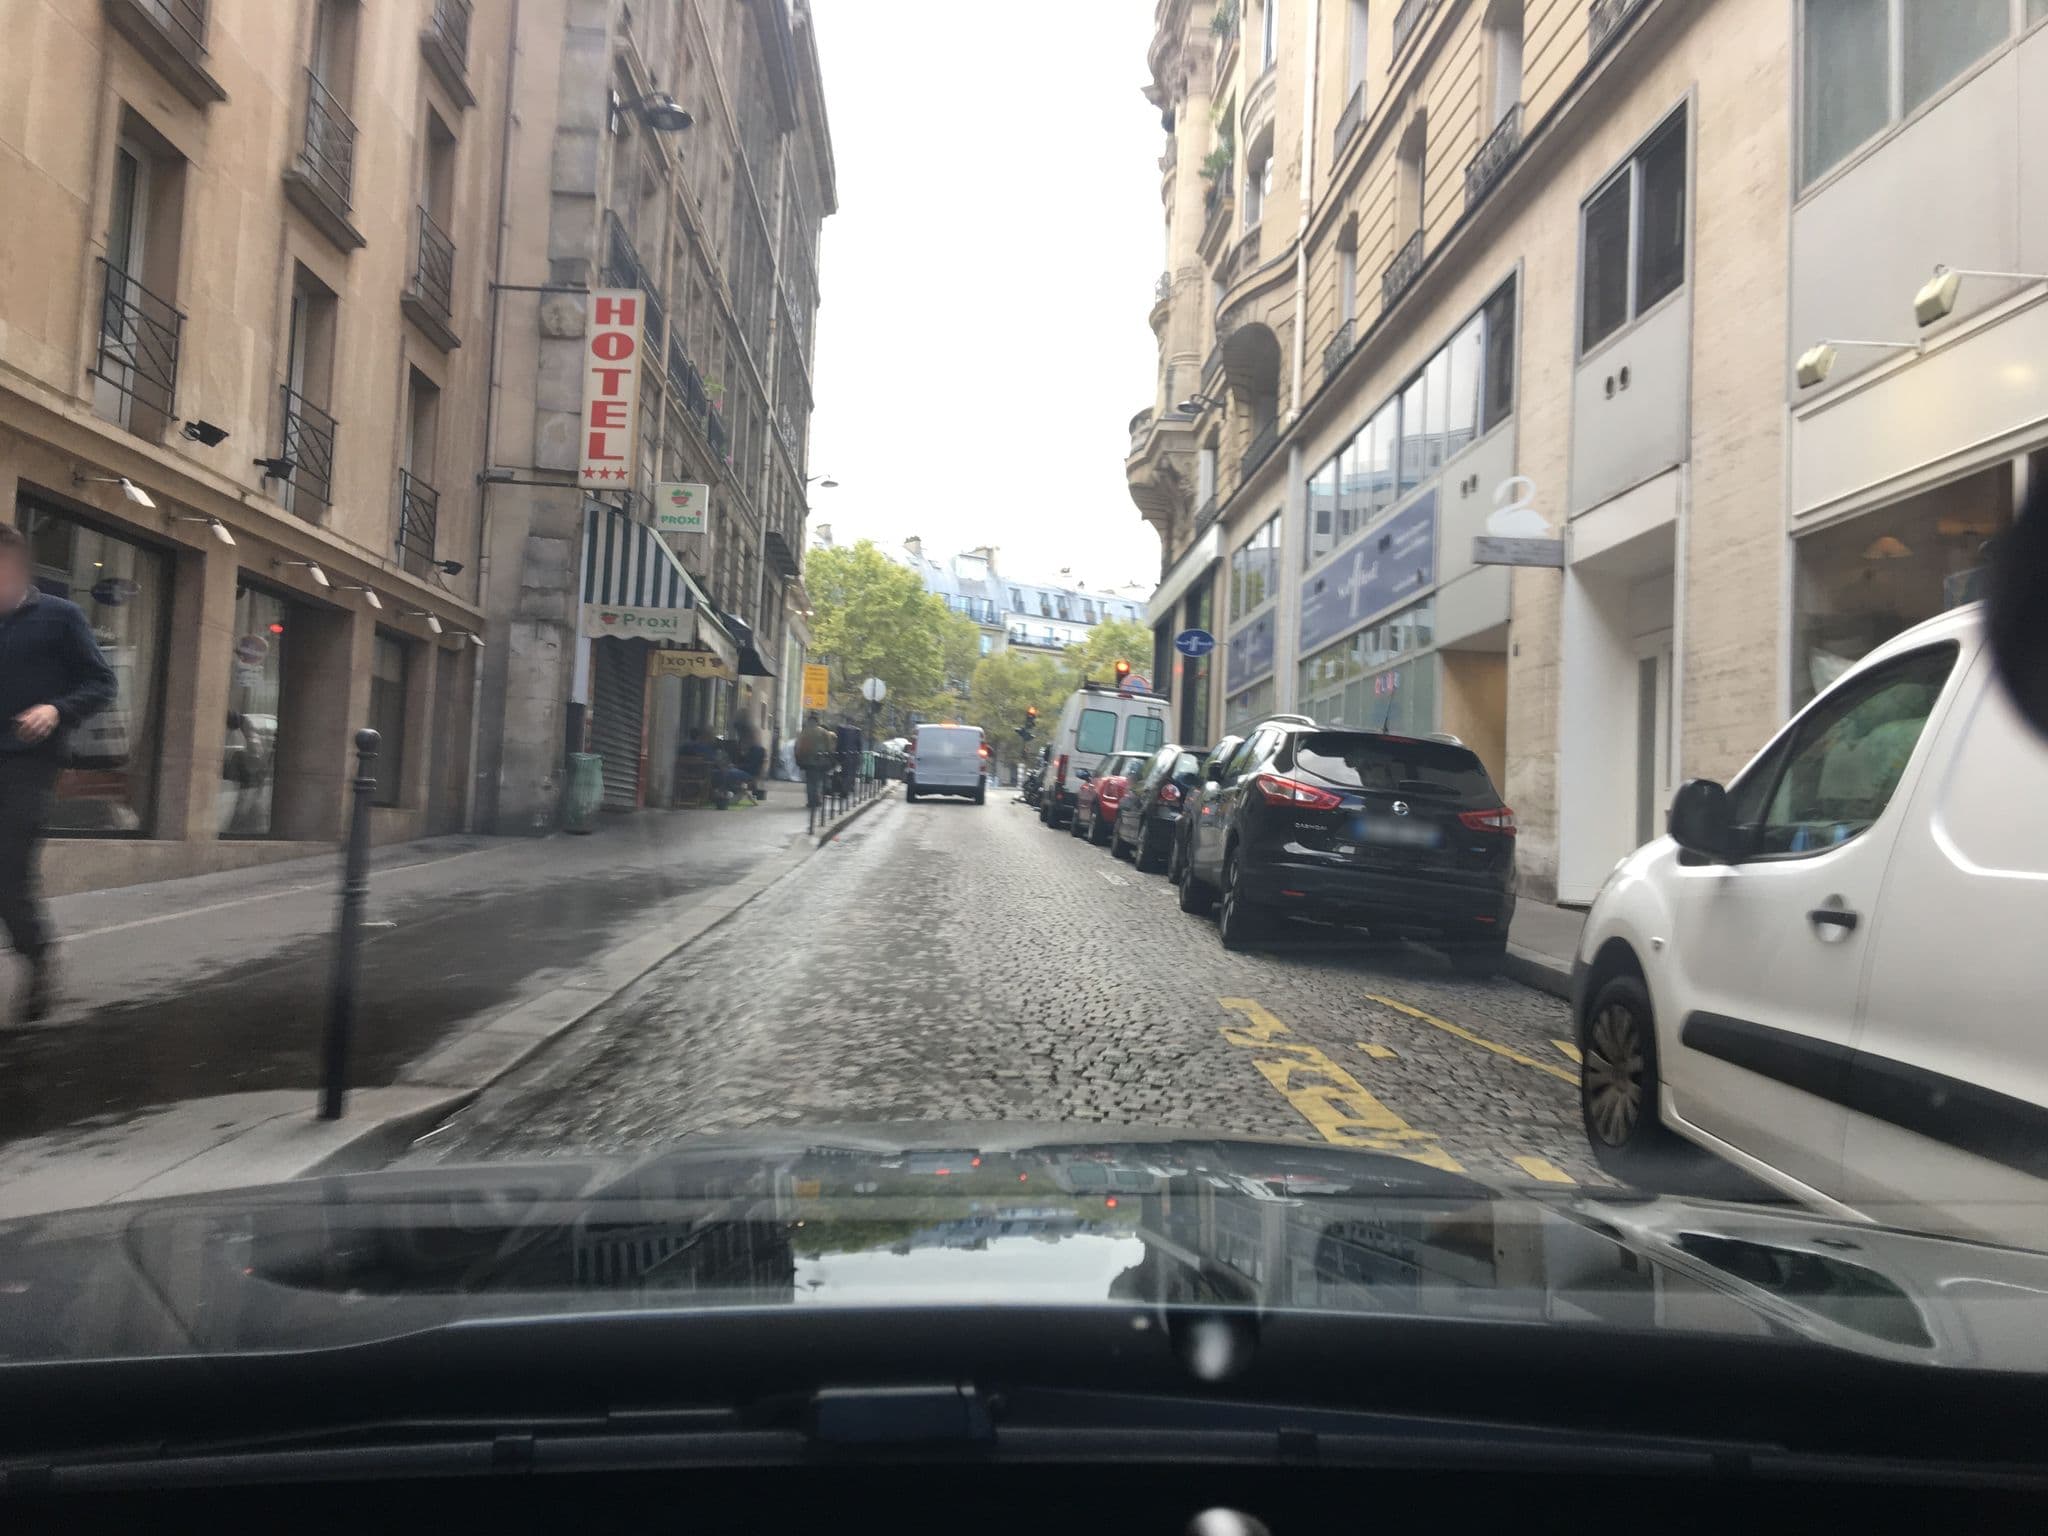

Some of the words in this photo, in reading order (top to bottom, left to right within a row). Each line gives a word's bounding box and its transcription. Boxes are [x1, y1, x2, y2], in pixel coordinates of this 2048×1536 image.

[588, 297, 636, 461] HOTEL
[661, 513, 701, 525] PROXI
[623, 613, 678, 628] Proxi
